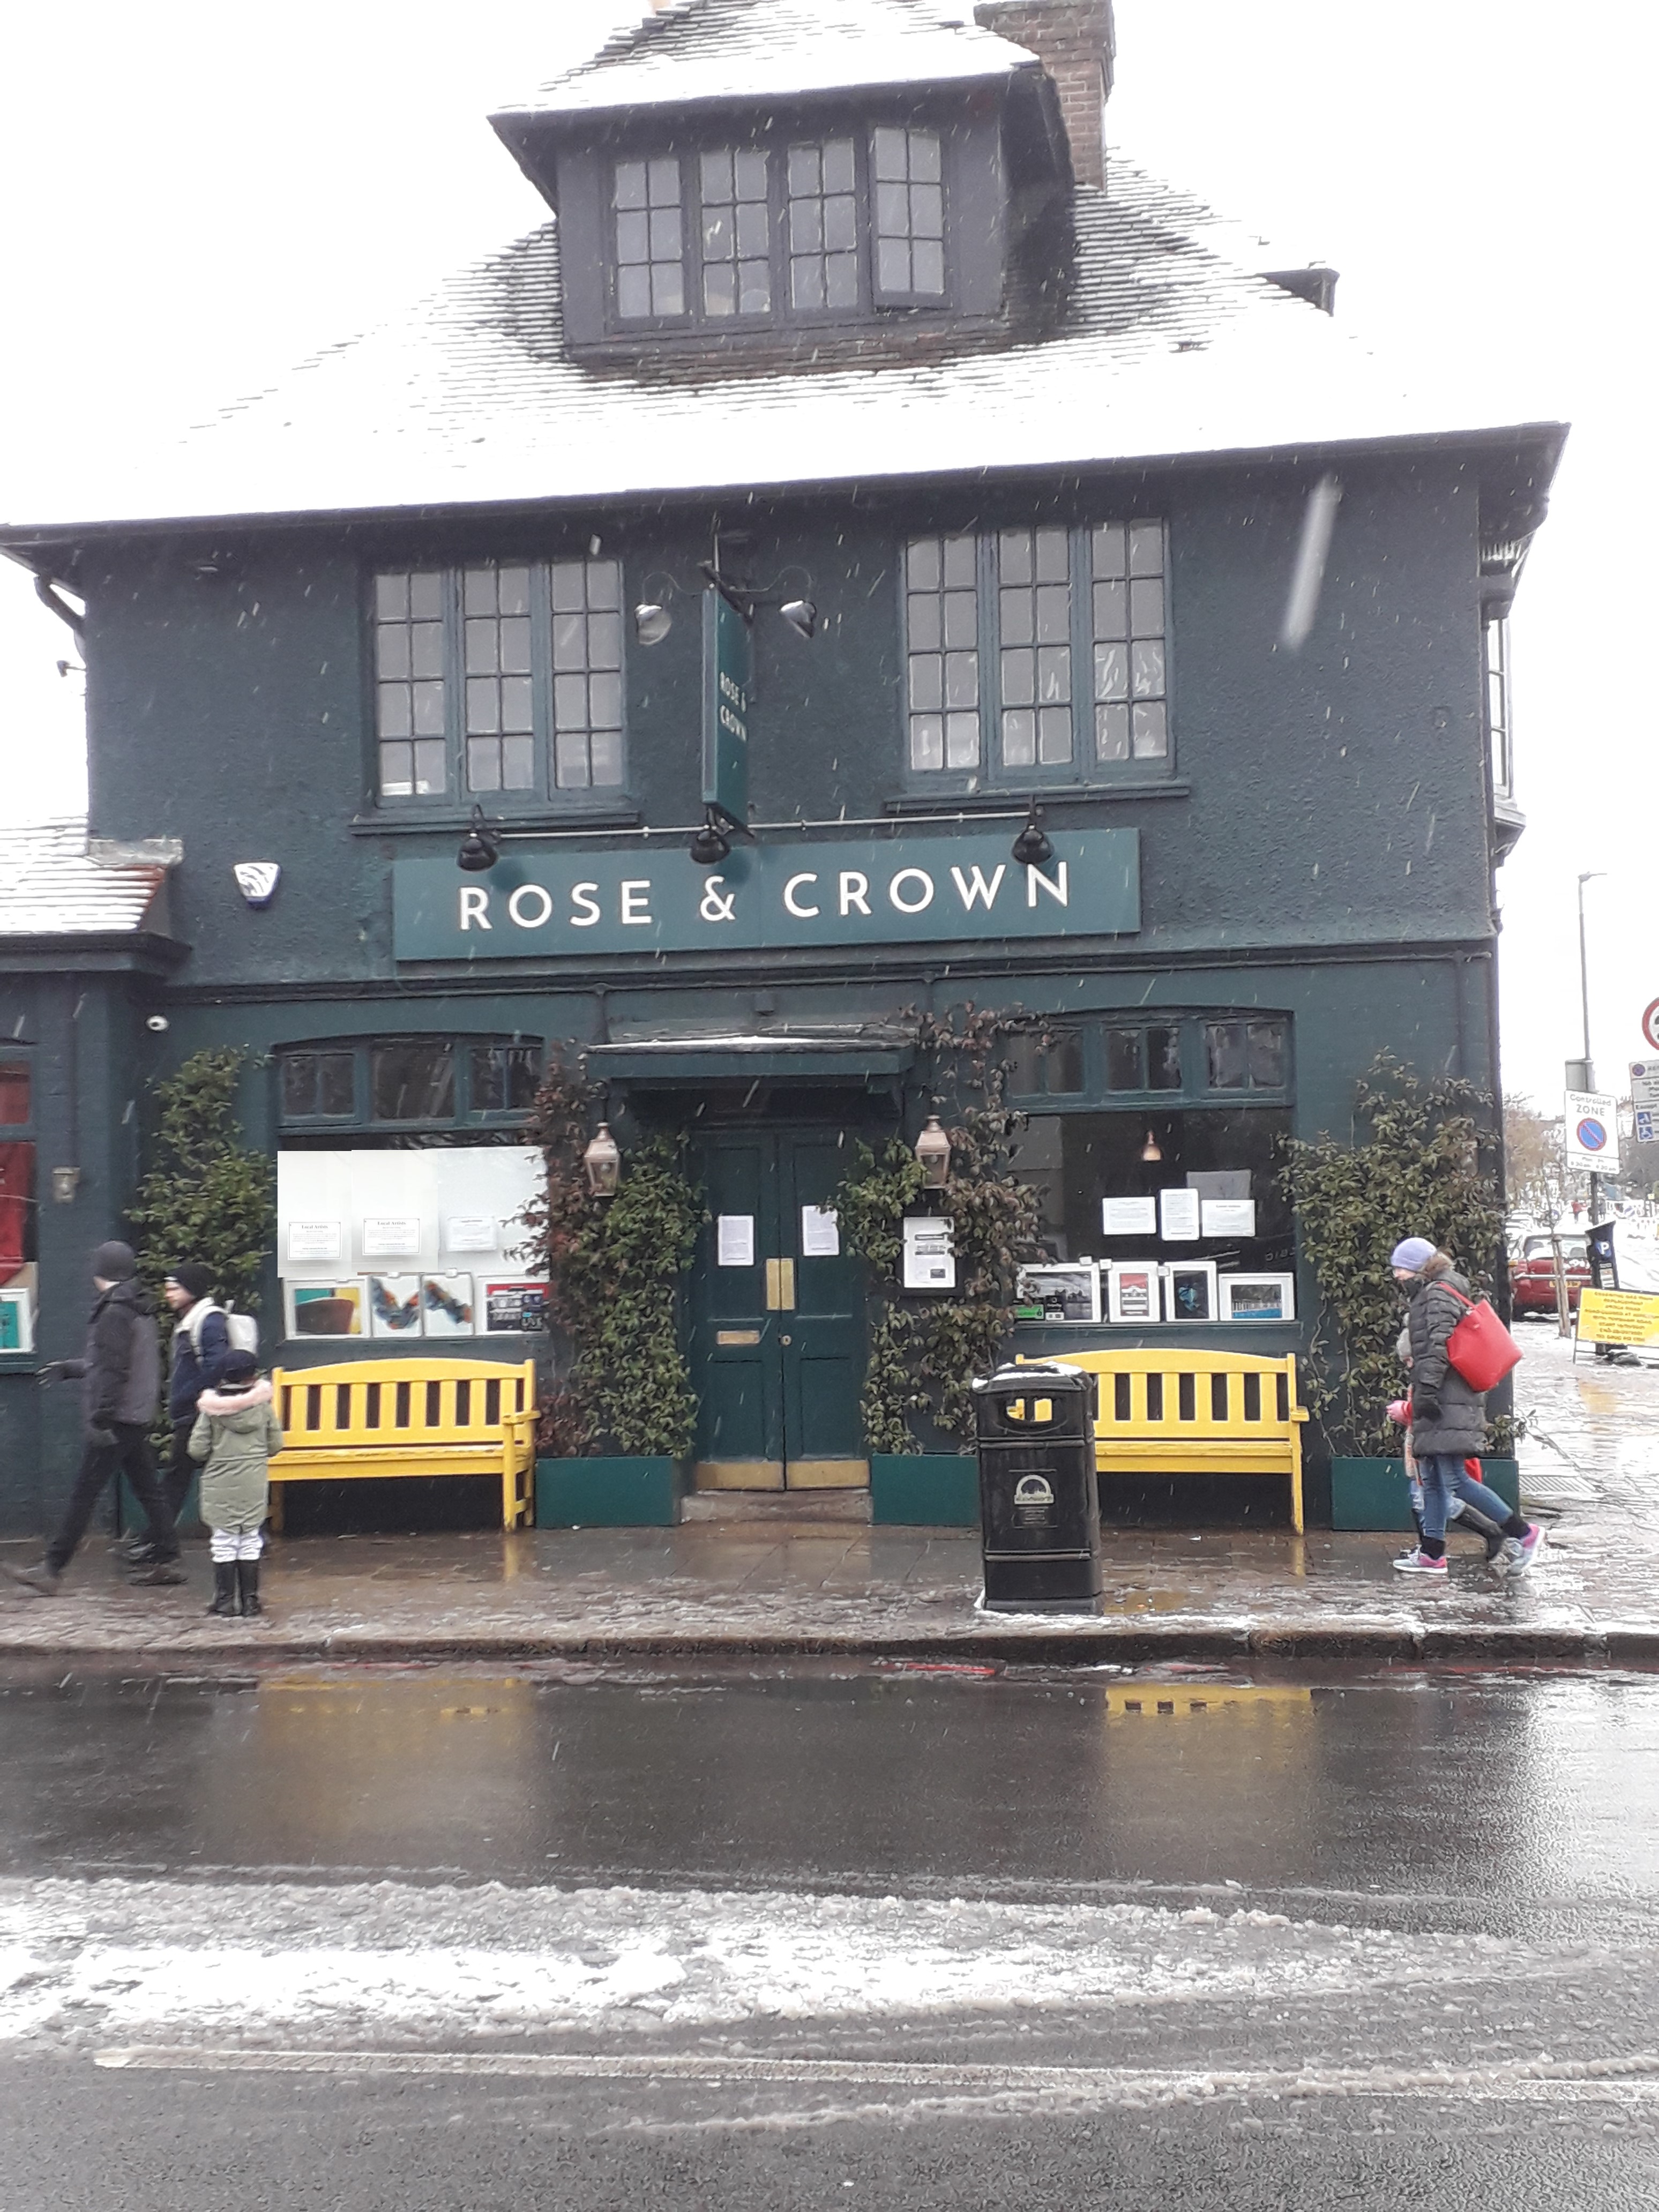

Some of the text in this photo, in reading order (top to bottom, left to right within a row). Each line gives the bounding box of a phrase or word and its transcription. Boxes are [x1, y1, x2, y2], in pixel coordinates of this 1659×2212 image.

[459, 861, 1068, 930] ROSE & CROWN
[1570, 1094, 1611, 1106] Controlled
[1576, 1104, 1605, 1116] ZONE
[1600, 1242, 1610, 1256] P
